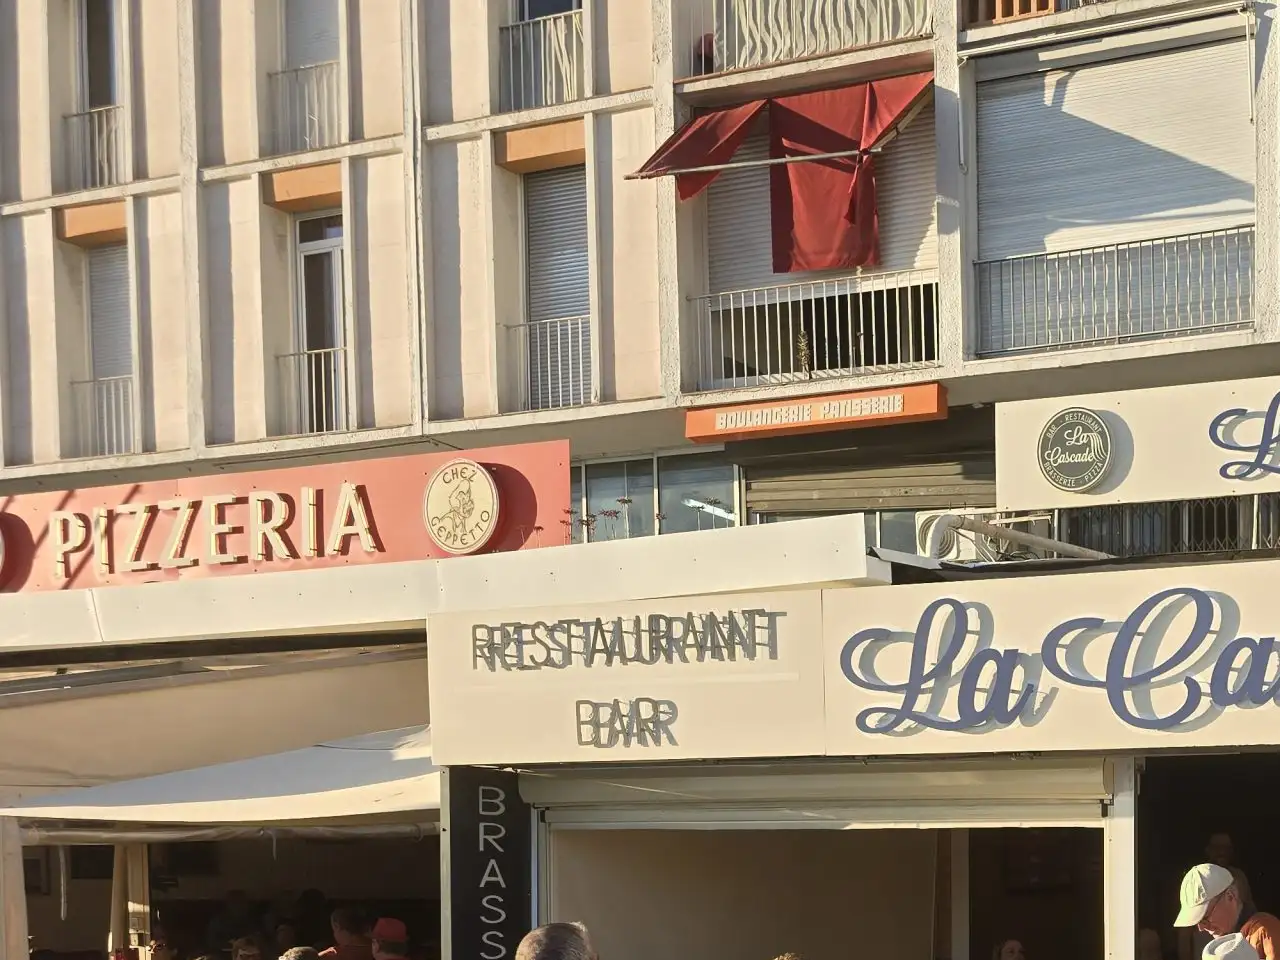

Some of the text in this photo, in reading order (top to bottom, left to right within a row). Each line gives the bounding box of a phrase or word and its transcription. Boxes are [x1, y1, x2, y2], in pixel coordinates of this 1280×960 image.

[716, 393, 905, 430] BOULANGERIE PATISSERIE
[1047, 413, 1102, 438] BAR RESTAURANT
[1064, 426, 1088, 445] La
[1044, 447, 1094, 466] Cascade
[1044, 461, 1104, 487] BRASSERIE PIZZA
[442, 467, 477, 484] CHEZ
[51, 483, 375, 579] PIZZERIA
[431, 510, 490, 545] GEPPETTO
[472, 608, 766, 671] RESTAURANT
[840, 598, 1035, 734] La
[576, 697, 661, 746] BAR
